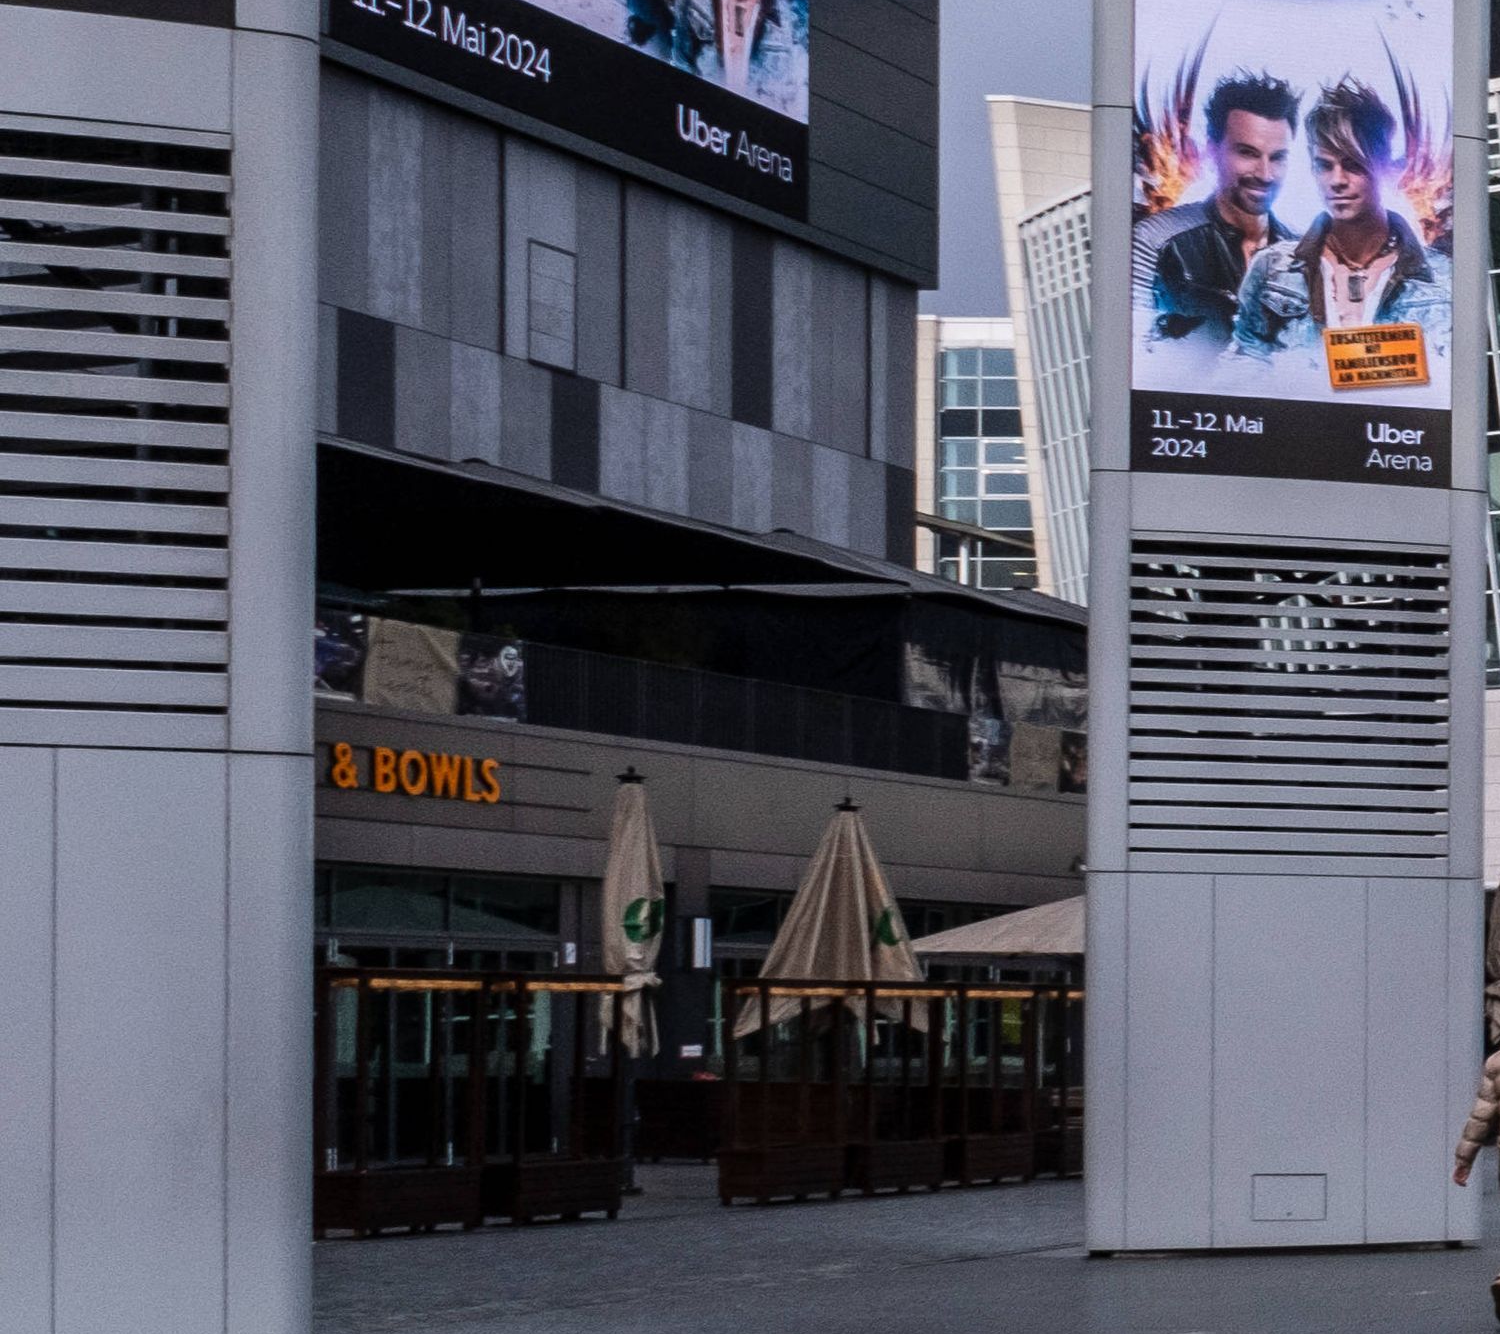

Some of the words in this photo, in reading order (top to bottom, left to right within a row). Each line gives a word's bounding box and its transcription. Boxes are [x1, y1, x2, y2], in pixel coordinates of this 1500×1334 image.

[441, 6, 487, 56] Mai
[491, 26, 552, 83] 2024
[676, 103, 732, 157] Uber
[734, 129, 793, 182] Arena
[1225, 415, 1264, 434] Mai
[1366, 422, 1424, 446] Uber
[1151, 438, 1206, 458] 2024
[1365, 448, 1433, 472] Arena
[332, 742, 358, 788] &
[375, 746, 500, 803] BOWLS
